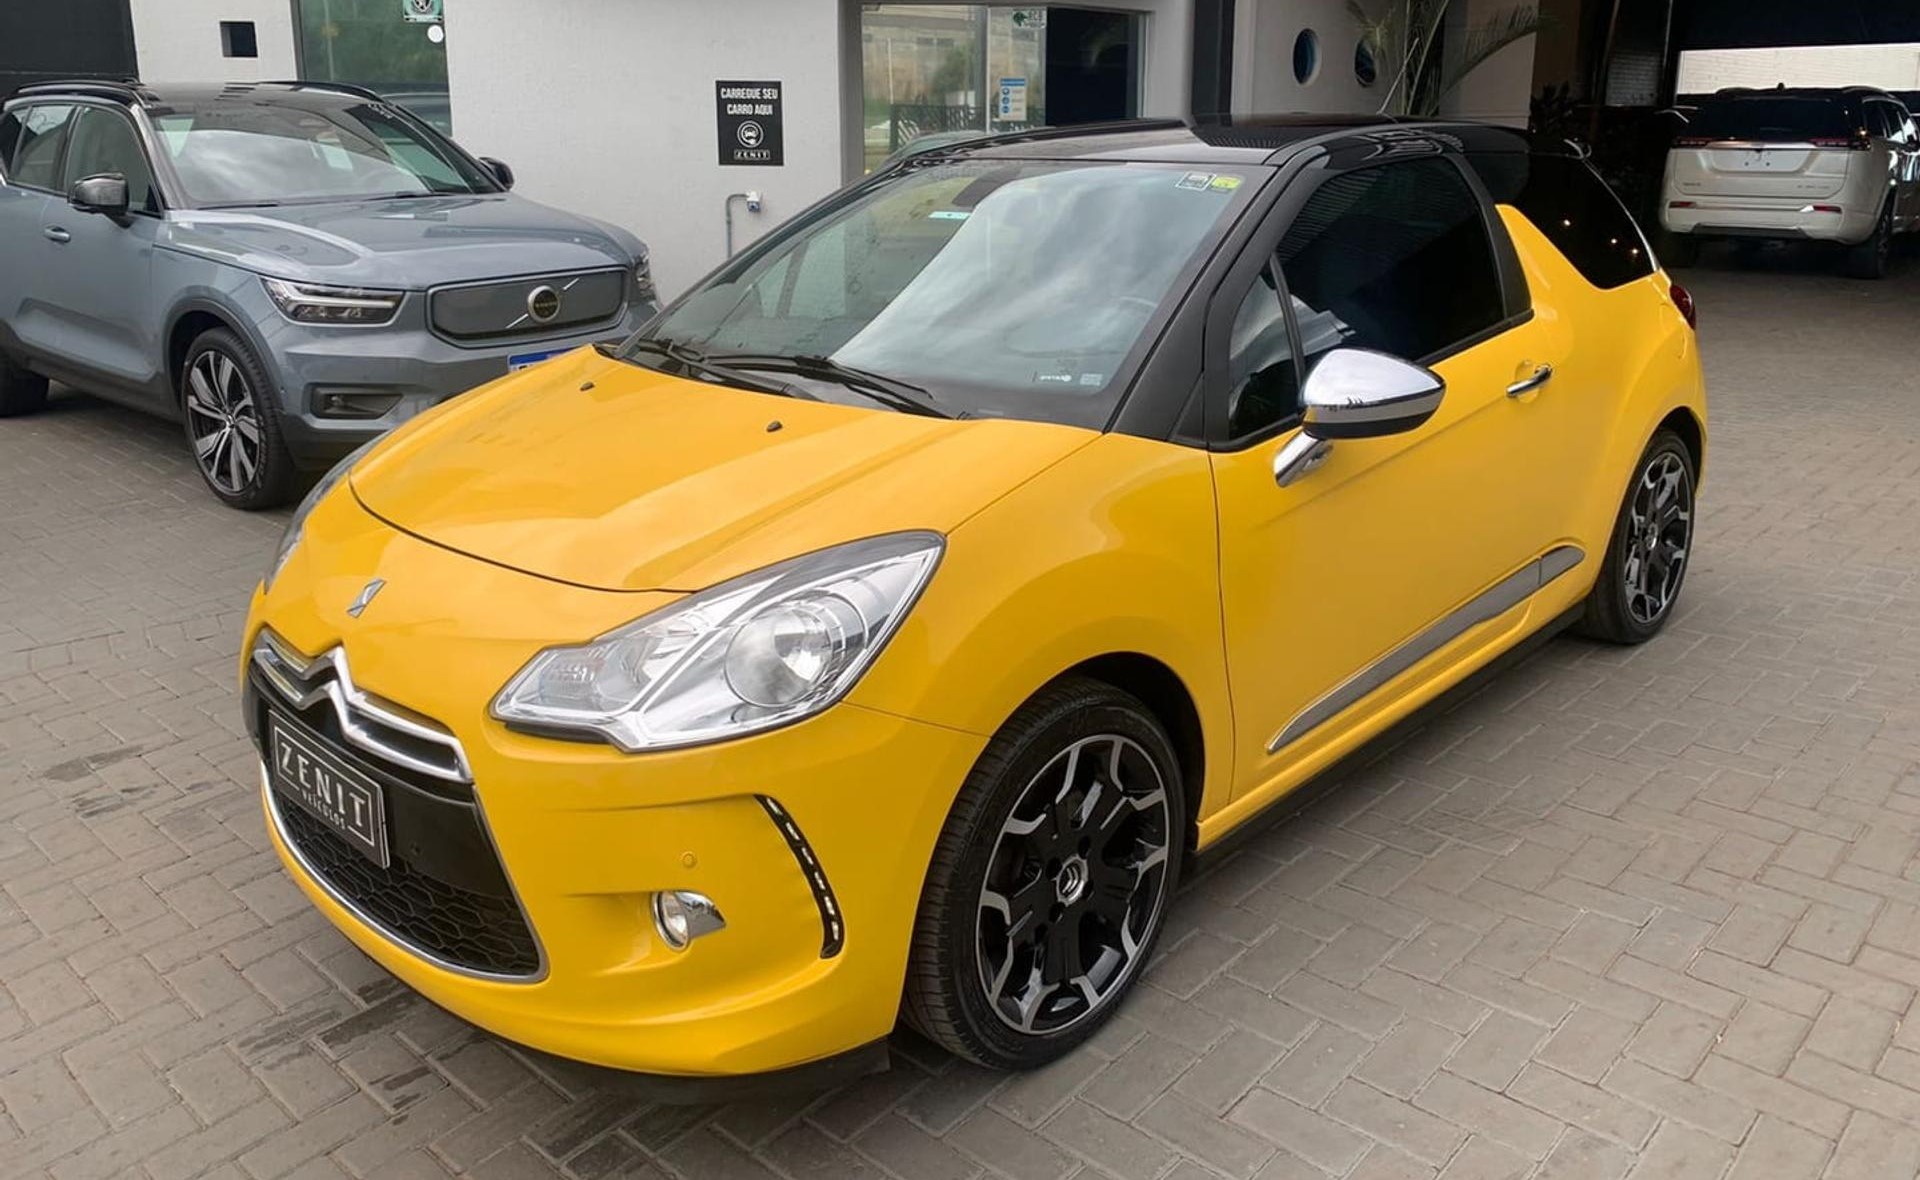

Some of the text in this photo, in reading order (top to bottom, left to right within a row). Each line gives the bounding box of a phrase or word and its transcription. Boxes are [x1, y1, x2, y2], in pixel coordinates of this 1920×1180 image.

[721, 88, 778, 99] CARREGUE SEU
[727, 104, 773, 115] CARRO AQUI
[281, 742, 366, 827] ZENIT
